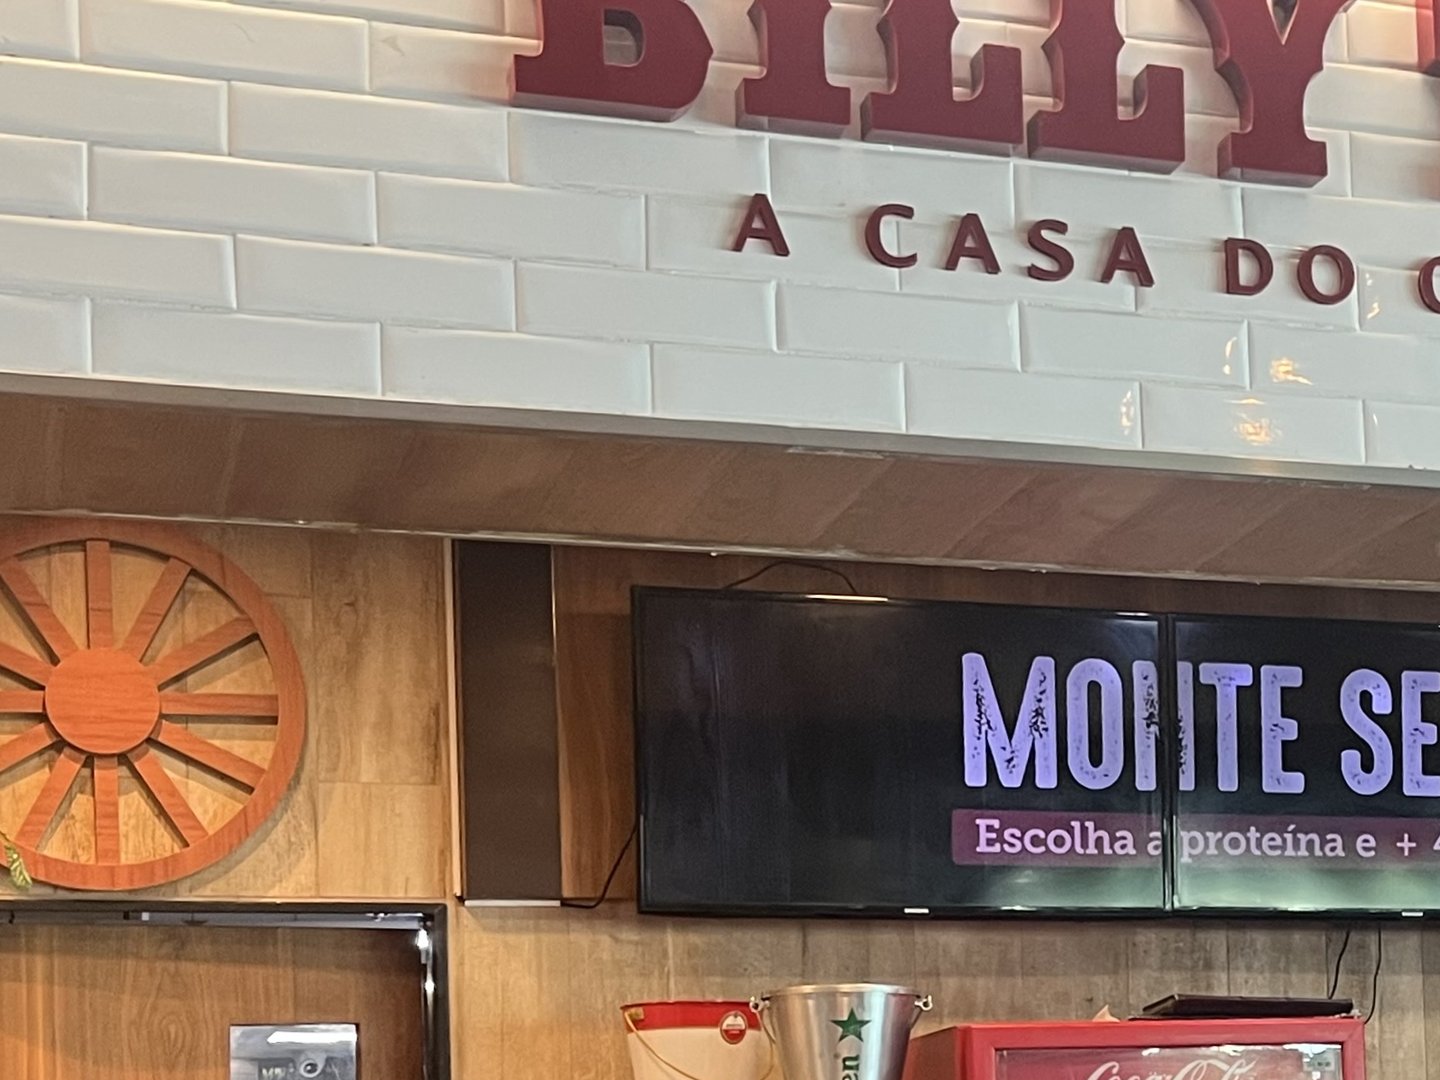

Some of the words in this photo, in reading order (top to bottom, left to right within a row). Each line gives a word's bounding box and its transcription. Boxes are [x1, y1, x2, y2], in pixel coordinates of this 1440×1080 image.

[511, 0, 1345, 188] BILLY
[731, 193, 790, 257] A
[864, 203, 1154, 288] CASA
[1224, 238, 1355, 305] DO
[961, 651, 1305, 794] MONTE
[976, 818, 1136, 856] Escolha
[1147, 831, 1163, 856] a
[1179, 823, 1342, 864] proteína
[1355, 832, 1376, 857] e
